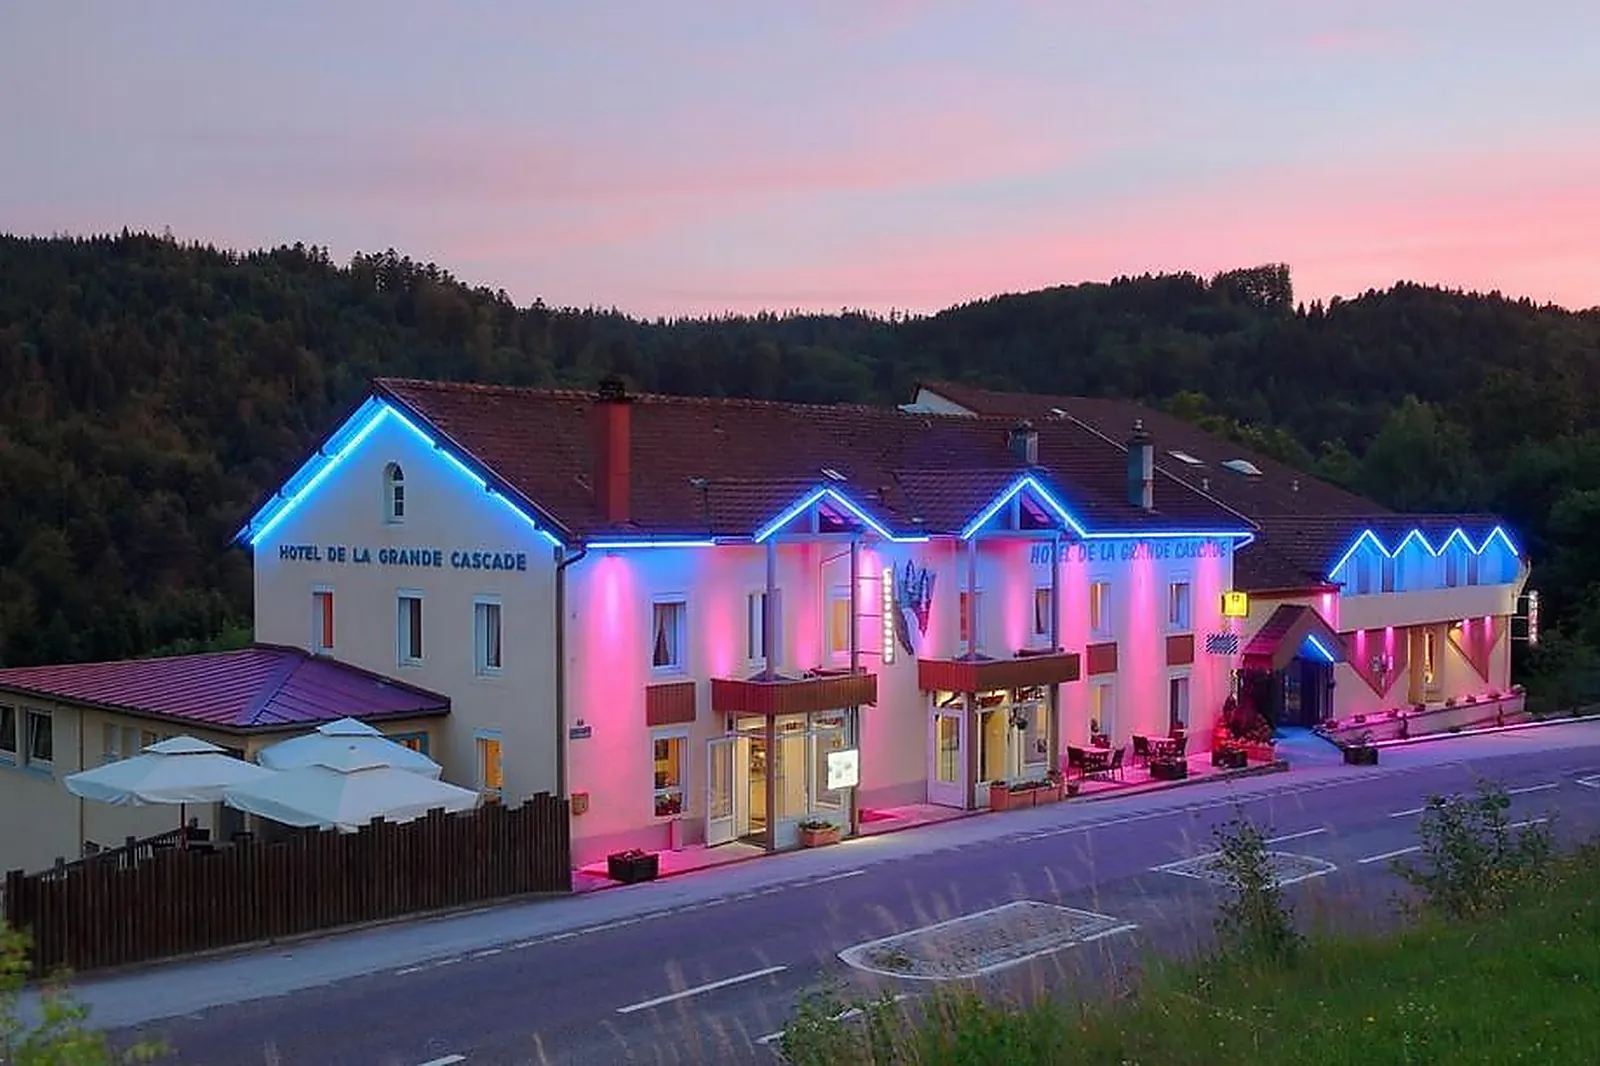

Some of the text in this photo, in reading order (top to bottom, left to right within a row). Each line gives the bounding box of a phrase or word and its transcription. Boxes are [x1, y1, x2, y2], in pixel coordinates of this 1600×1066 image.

[279, 544, 527, 572] HOTEL DE LA GRANDE CASCADE
[1031, 542, 1071, 564] HOEL
[1078, 542, 1095, 563] DE
[1100, 542, 1115, 562] LA
[1121, 541, 1171, 561] GRANDE
